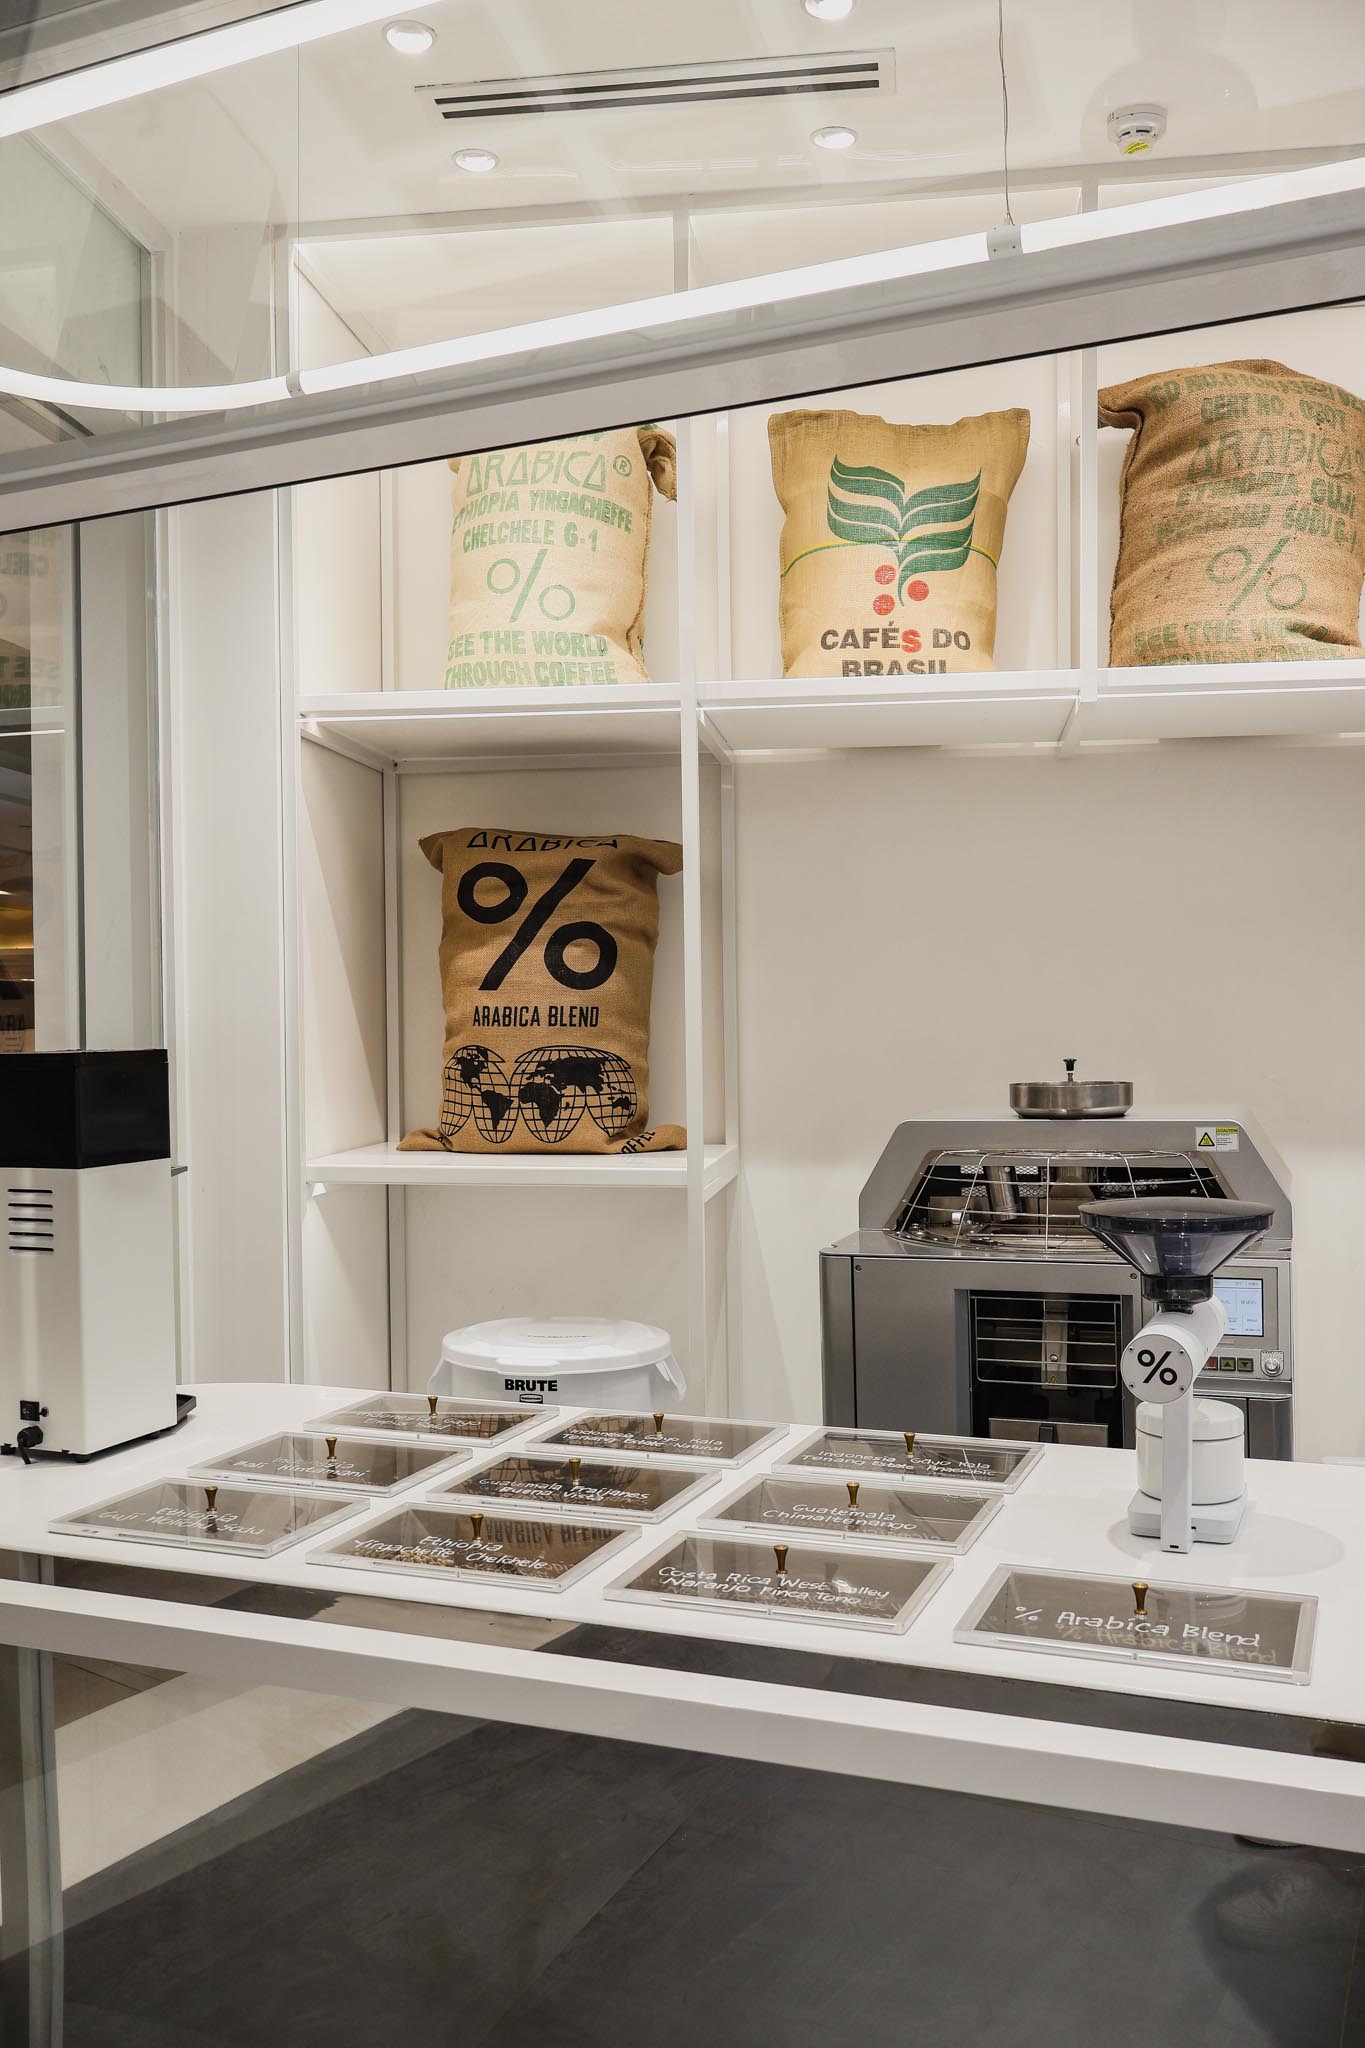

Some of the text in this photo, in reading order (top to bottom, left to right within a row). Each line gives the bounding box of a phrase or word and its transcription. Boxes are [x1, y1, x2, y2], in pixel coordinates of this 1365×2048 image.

[1187, 427, 1352, 485] ARABICA
[466, 451, 607, 497] ARABICA
[452, 489, 633, 536] ETHIOPIA YIRGACHEFFE
[463, 520, 555, 553] CHELCHELE
[448, 630, 608, 661] SEE THE WORLD
[820, 621, 971, 653] CAFÉS DO
[1135, 623, 1178, 657] SEE
[1185, 619, 1242, 646] THE
[534, 660, 618, 687] COFFEE
[472, 1005, 600, 1028] ARABICA BLEND
[504, 1378, 558, 1392] BRUTE
[802, 1454, 865, 1467] Tenang
[926, 1463, 996, 1477] Anaerobic
[817, 1450, 897, 1463] Indonesia
[910, 1456, 951, 1467] Gayo
[479, 1478, 650, 1501] Guatemala Fraijanes
[762, 1510, 918, 1530] Chimaltenango
[792, 1503, 897, 1521] Guatemala
[353, 1538, 550, 1570] Yirgacheffe Chelchele
[418, 1535, 504, 1553] Ethiopia
[658, 1566, 717, 1580] Costa
[725, 1572, 770, 1586] Rica
[779, 1577, 828, 1591] West
[662, 1577, 752, 1593] Naranjo
[759, 1585, 809, 1600] Finca
[1057, 1611, 1169, 1637] Arabica
[1182, 1623, 1261, 1647] Blend
